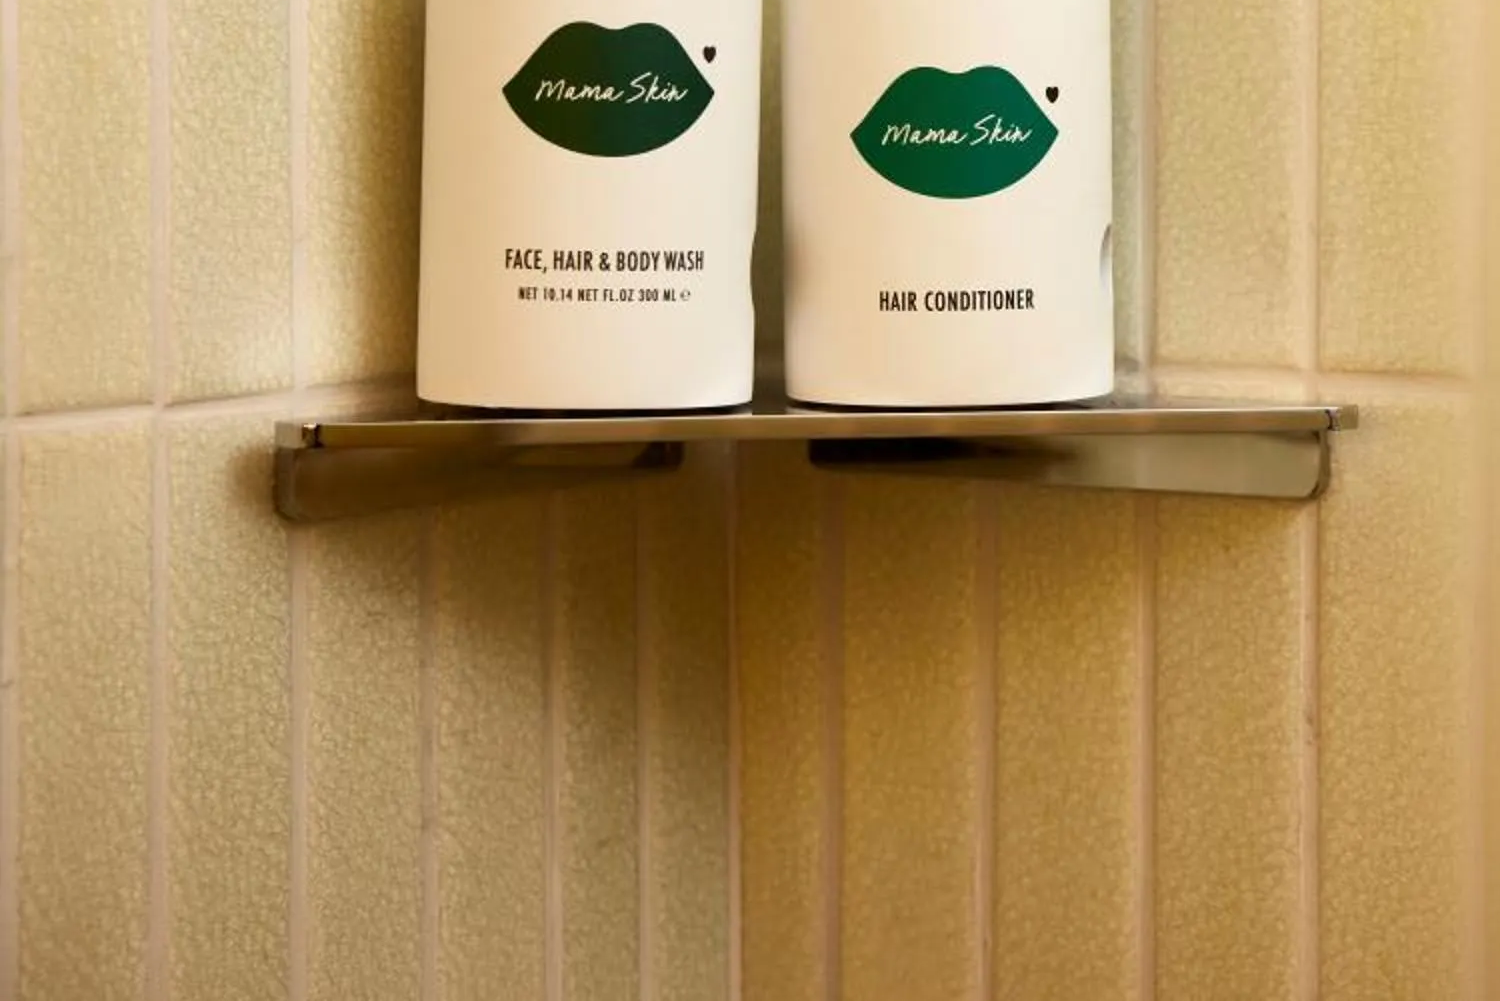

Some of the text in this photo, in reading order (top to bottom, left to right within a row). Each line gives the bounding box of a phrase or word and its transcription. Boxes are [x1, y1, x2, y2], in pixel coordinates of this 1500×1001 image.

[535, 71, 689, 103] Mama Skin
[881, 114, 1033, 146] Mama Skin
[504, 248, 705, 274] FACE, HAIR & BODY WASH
[518, 286, 538, 300] NET
[543, 287, 573, 301] 10.14
[577, 288, 599, 302] NET
[603, 288, 634, 302] FL.OZ
[638, 289, 659, 302] 300
[663, 289, 676, 302] ML
[879, 289, 1035, 312] HAIR CONDITIONER
